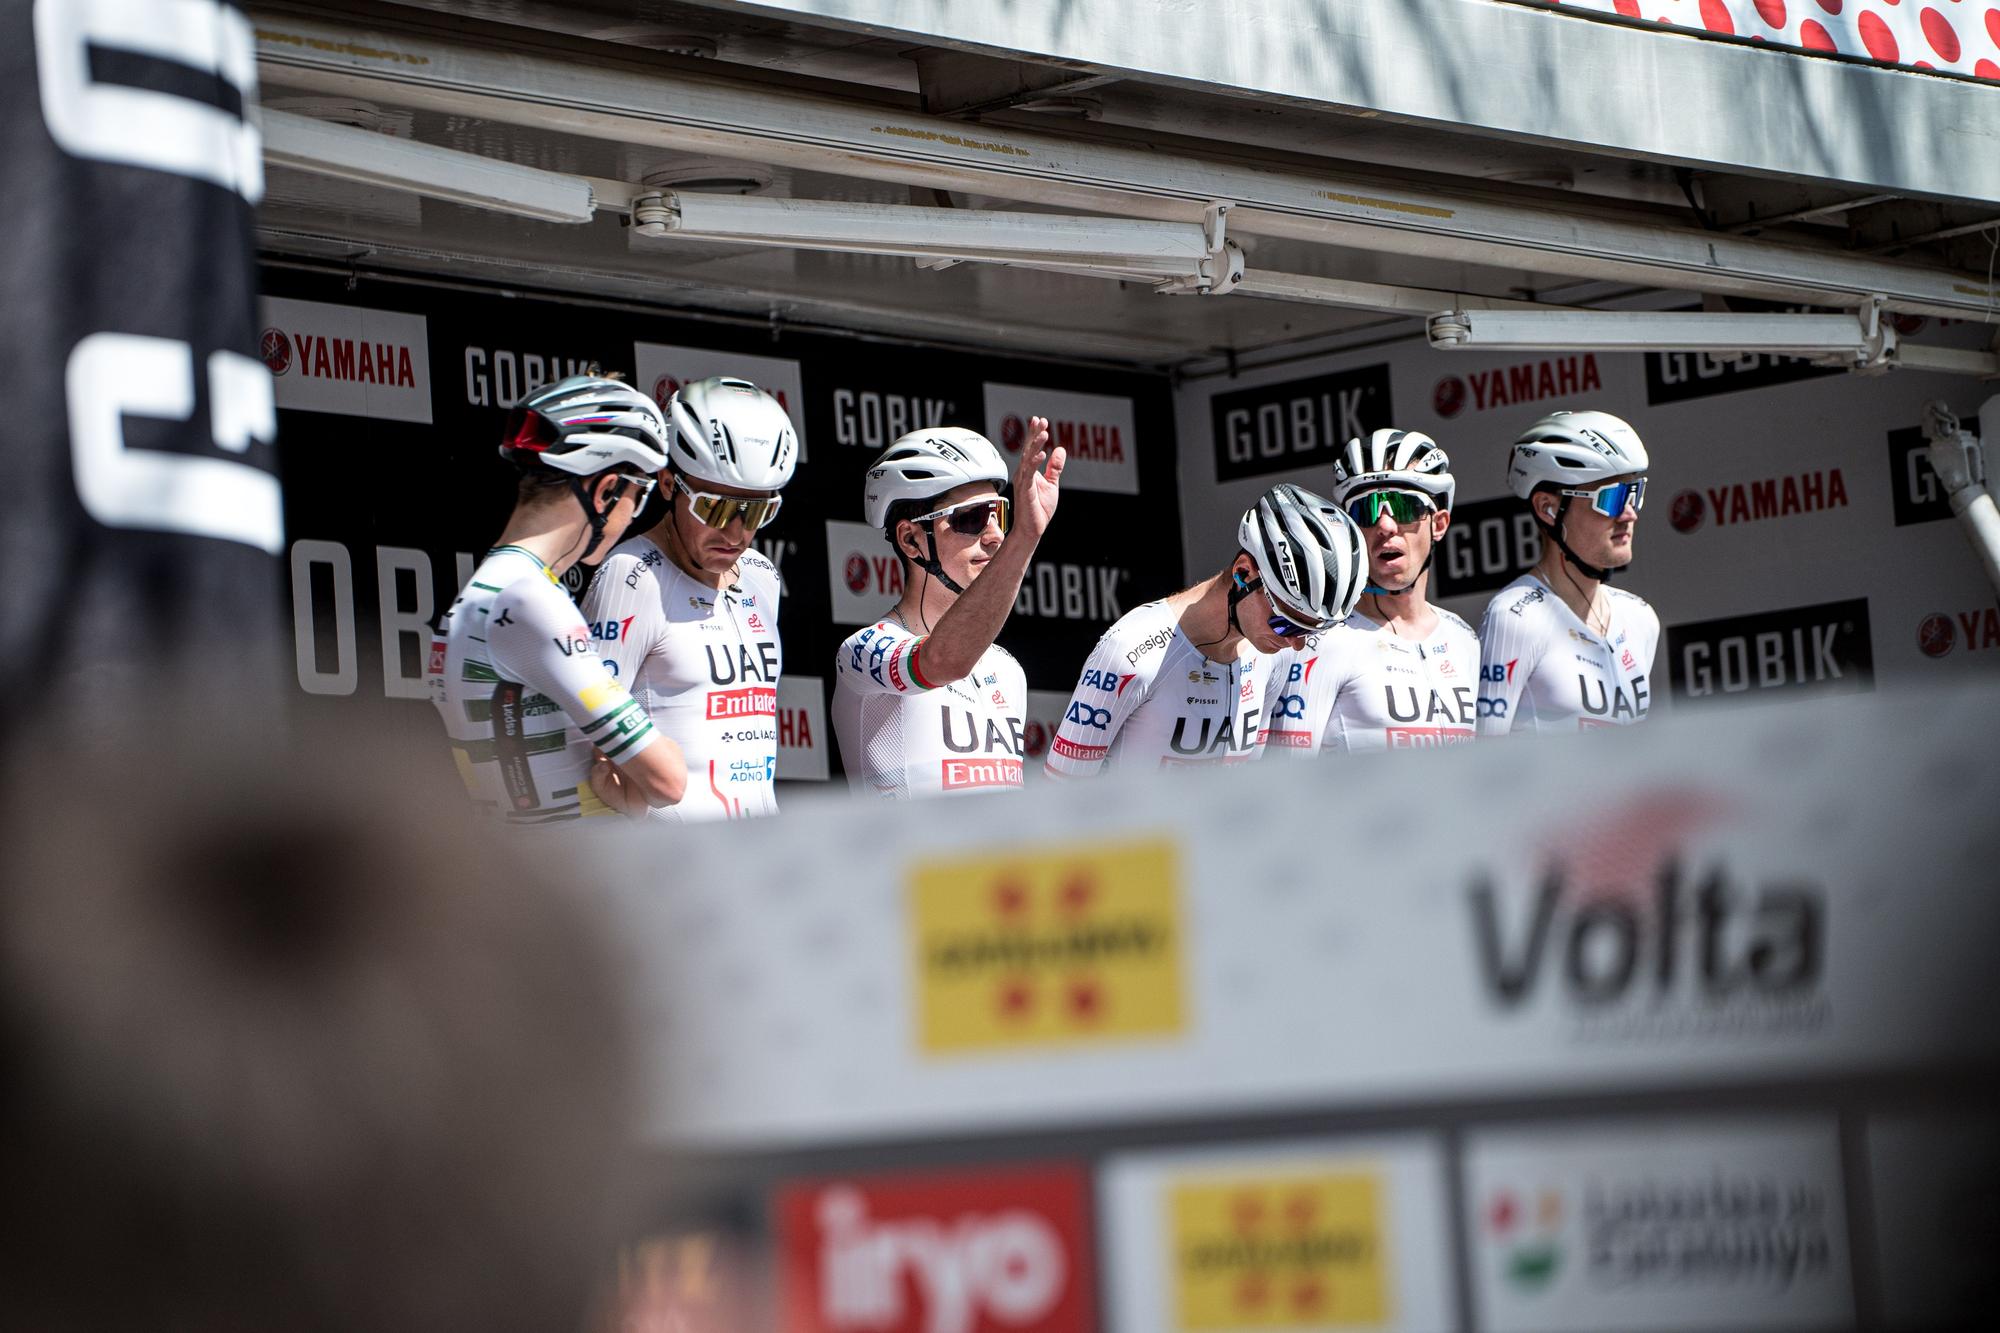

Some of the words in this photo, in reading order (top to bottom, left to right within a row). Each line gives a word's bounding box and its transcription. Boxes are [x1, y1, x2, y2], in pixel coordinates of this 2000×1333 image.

[294, 334, 415, 388] YAMAHA
[1468, 352, 1601, 411] YAMAHA
[709, 419, 728, 464] MET
[1028, 418, 1124, 463] AMAHA
[1226, 388, 1364, 462] GOBIK
[1580, 429, 1616, 457] MET
[925, 438, 965, 463] MET
[1423, 449, 1443, 467] ME
[1517, 447, 1539, 458] MET
[1708, 468, 1848, 526] YAMAHA
[1278, 541, 1299, 591] MET
[1014, 561, 1121, 622] GOBIK
[706, 642, 778, 685] UAE
[852, 629, 875, 673] FAB
[870, 636, 895, 688] ADQ
[1126, 626, 1177, 667] presight
[1684, 622, 1842, 697] GOBIK
[1081, 669, 1119, 692] FAB
[1480, 665, 1505, 682] AB
[1066, 701, 1111, 731] ADQ
[1271, 695, 1305, 720] DQ
[1385, 685, 1475, 724] UAE
[1477, 697, 1508, 719] DQ
[1579, 675, 1648, 719] UAE
[941, 705, 1024, 756] UAE
[1054, 737, 1106, 760] Emirates
[1170, 709, 1259, 754] UAE
[730, 771, 763, 782] ADNO
[947, 761, 1024, 785] Emirat
[1466, 850, 1829, 1011] Volta
[816, 1182, 1066, 1333] iryo
